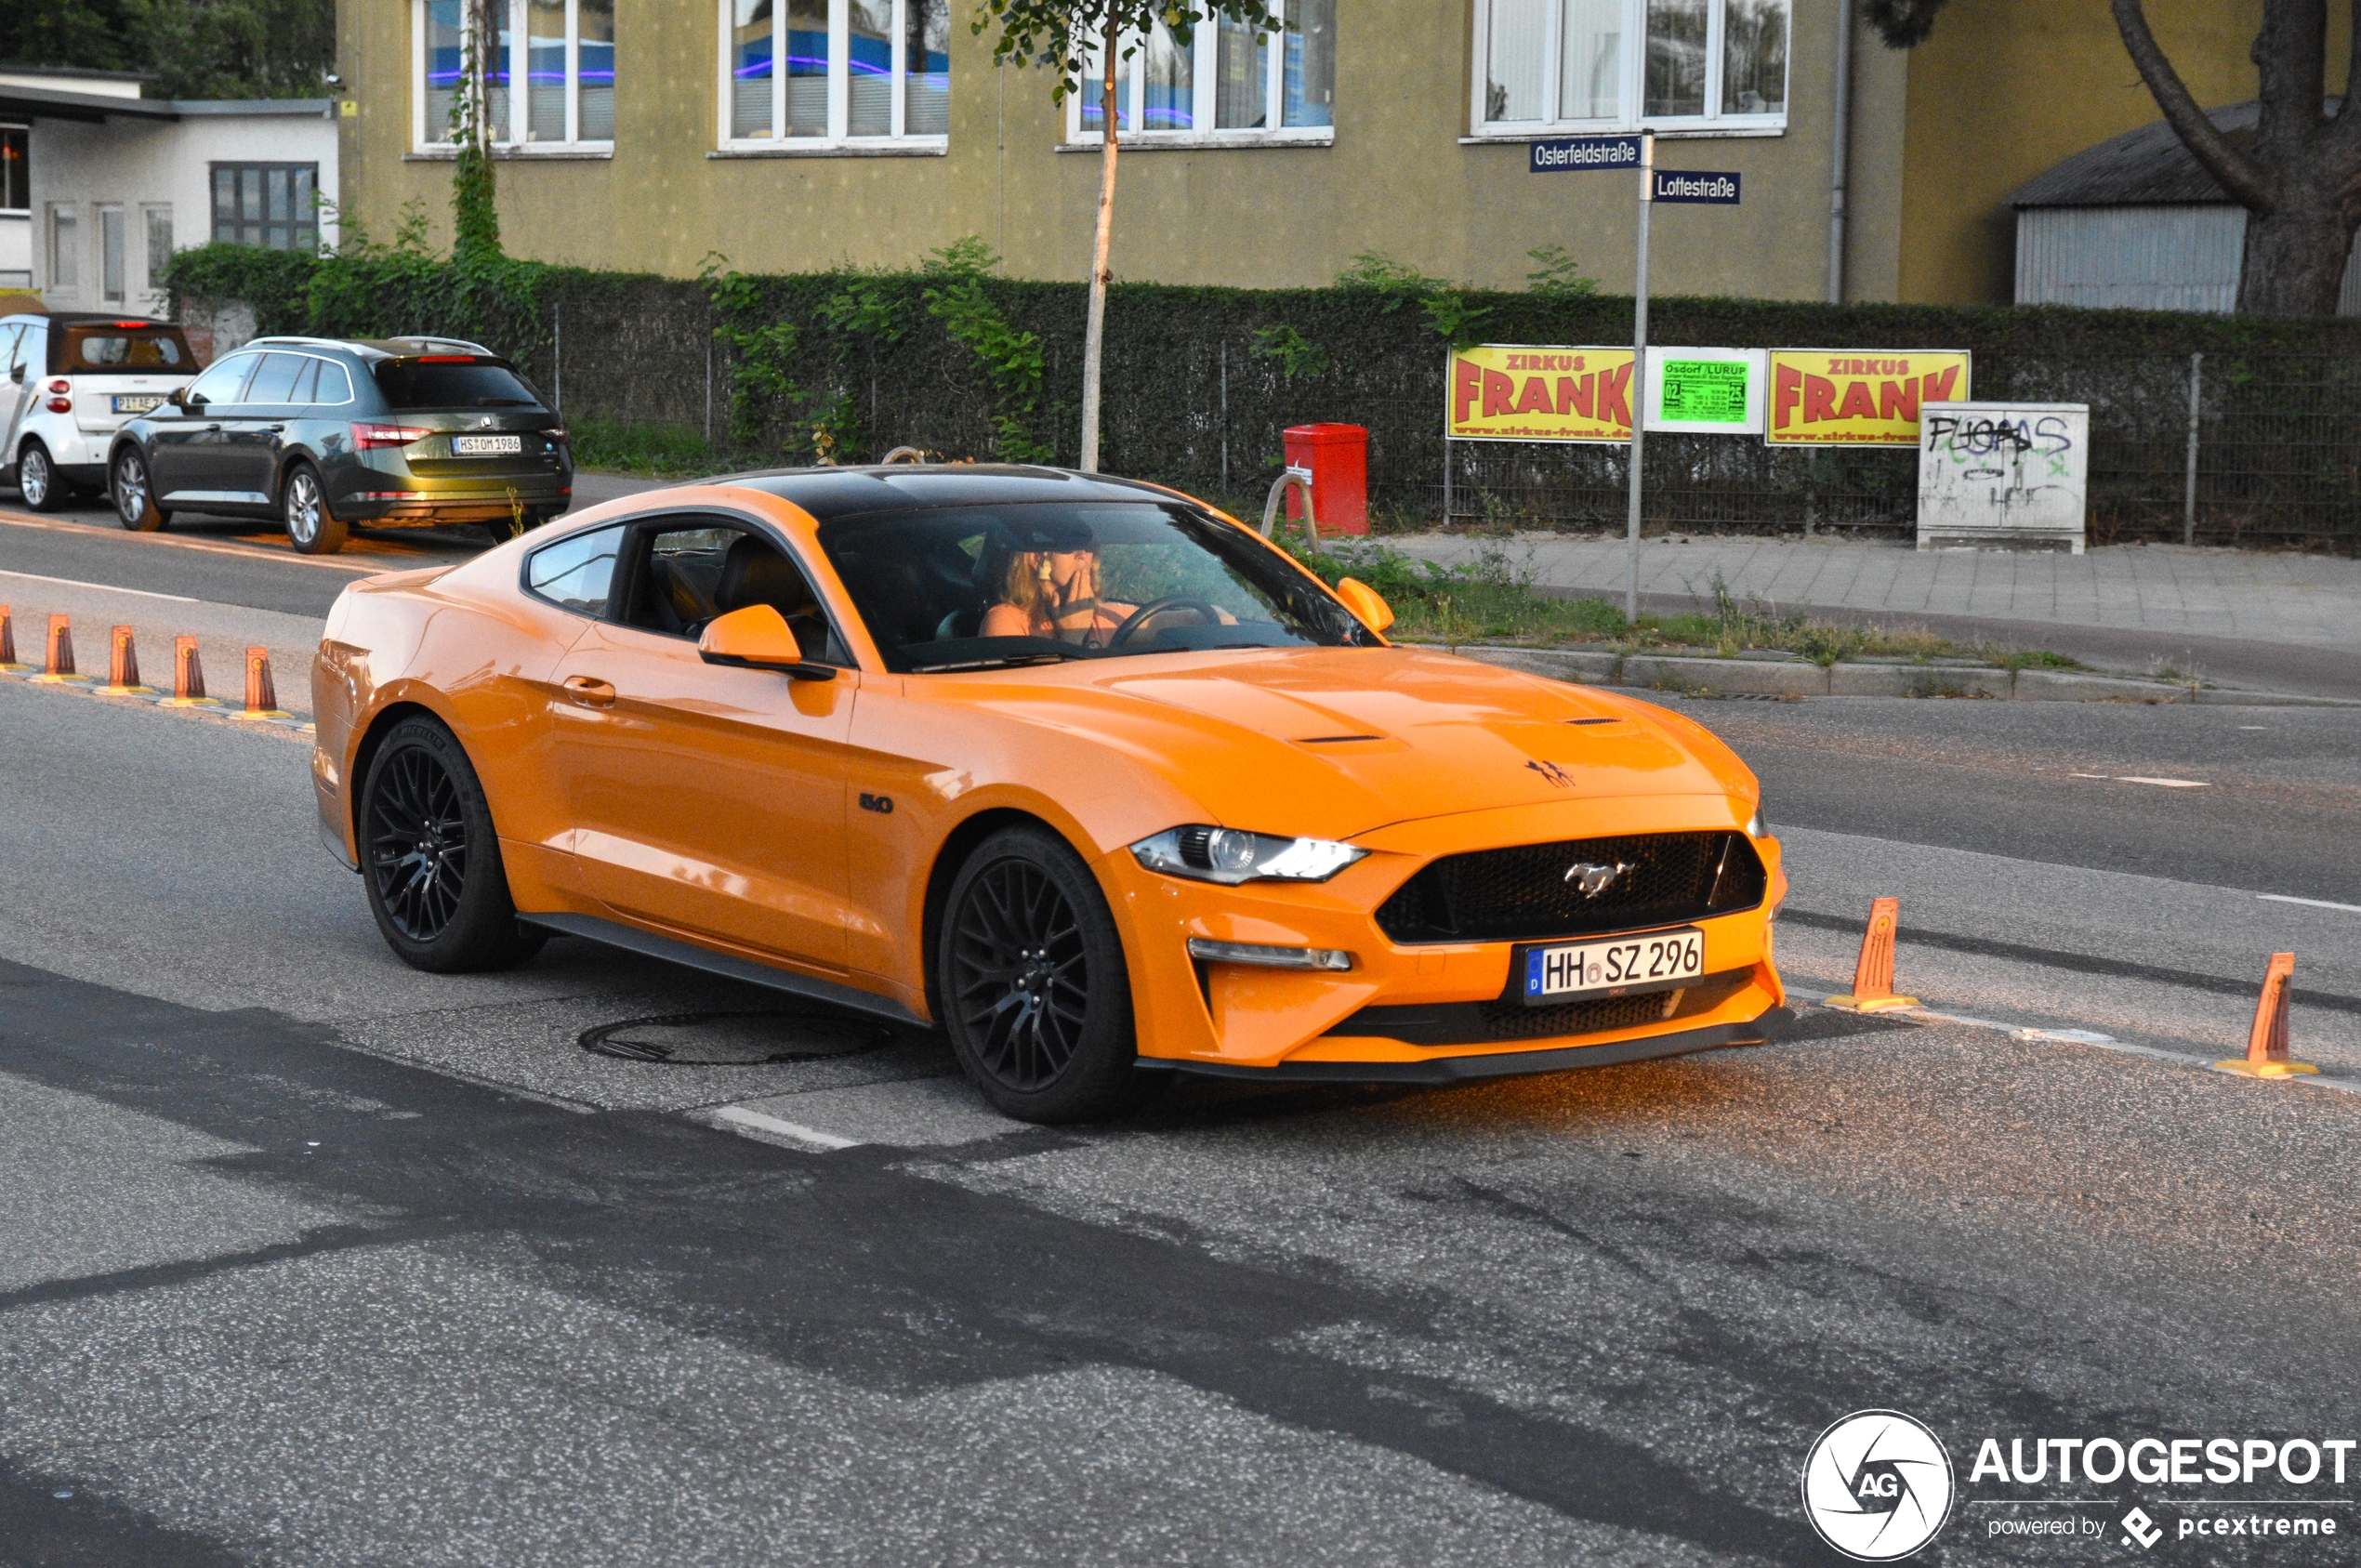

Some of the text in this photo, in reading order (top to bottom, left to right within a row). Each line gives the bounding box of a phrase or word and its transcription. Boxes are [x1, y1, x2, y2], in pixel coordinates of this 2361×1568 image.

[1535, 141, 1636, 165] Osterfeldstraße
[1657, 175, 1735, 197] Lottestraße
[1506, 354, 1586, 371] ZIRKUS
[1827, 359, 1909, 376] ZIRKUS
[1455, 357, 1634, 428] FRANK
[460, 439, 474, 450] HS
[495, 438, 520, 450] 1986
[1530, 937, 1699, 991] D HH SZ 296
